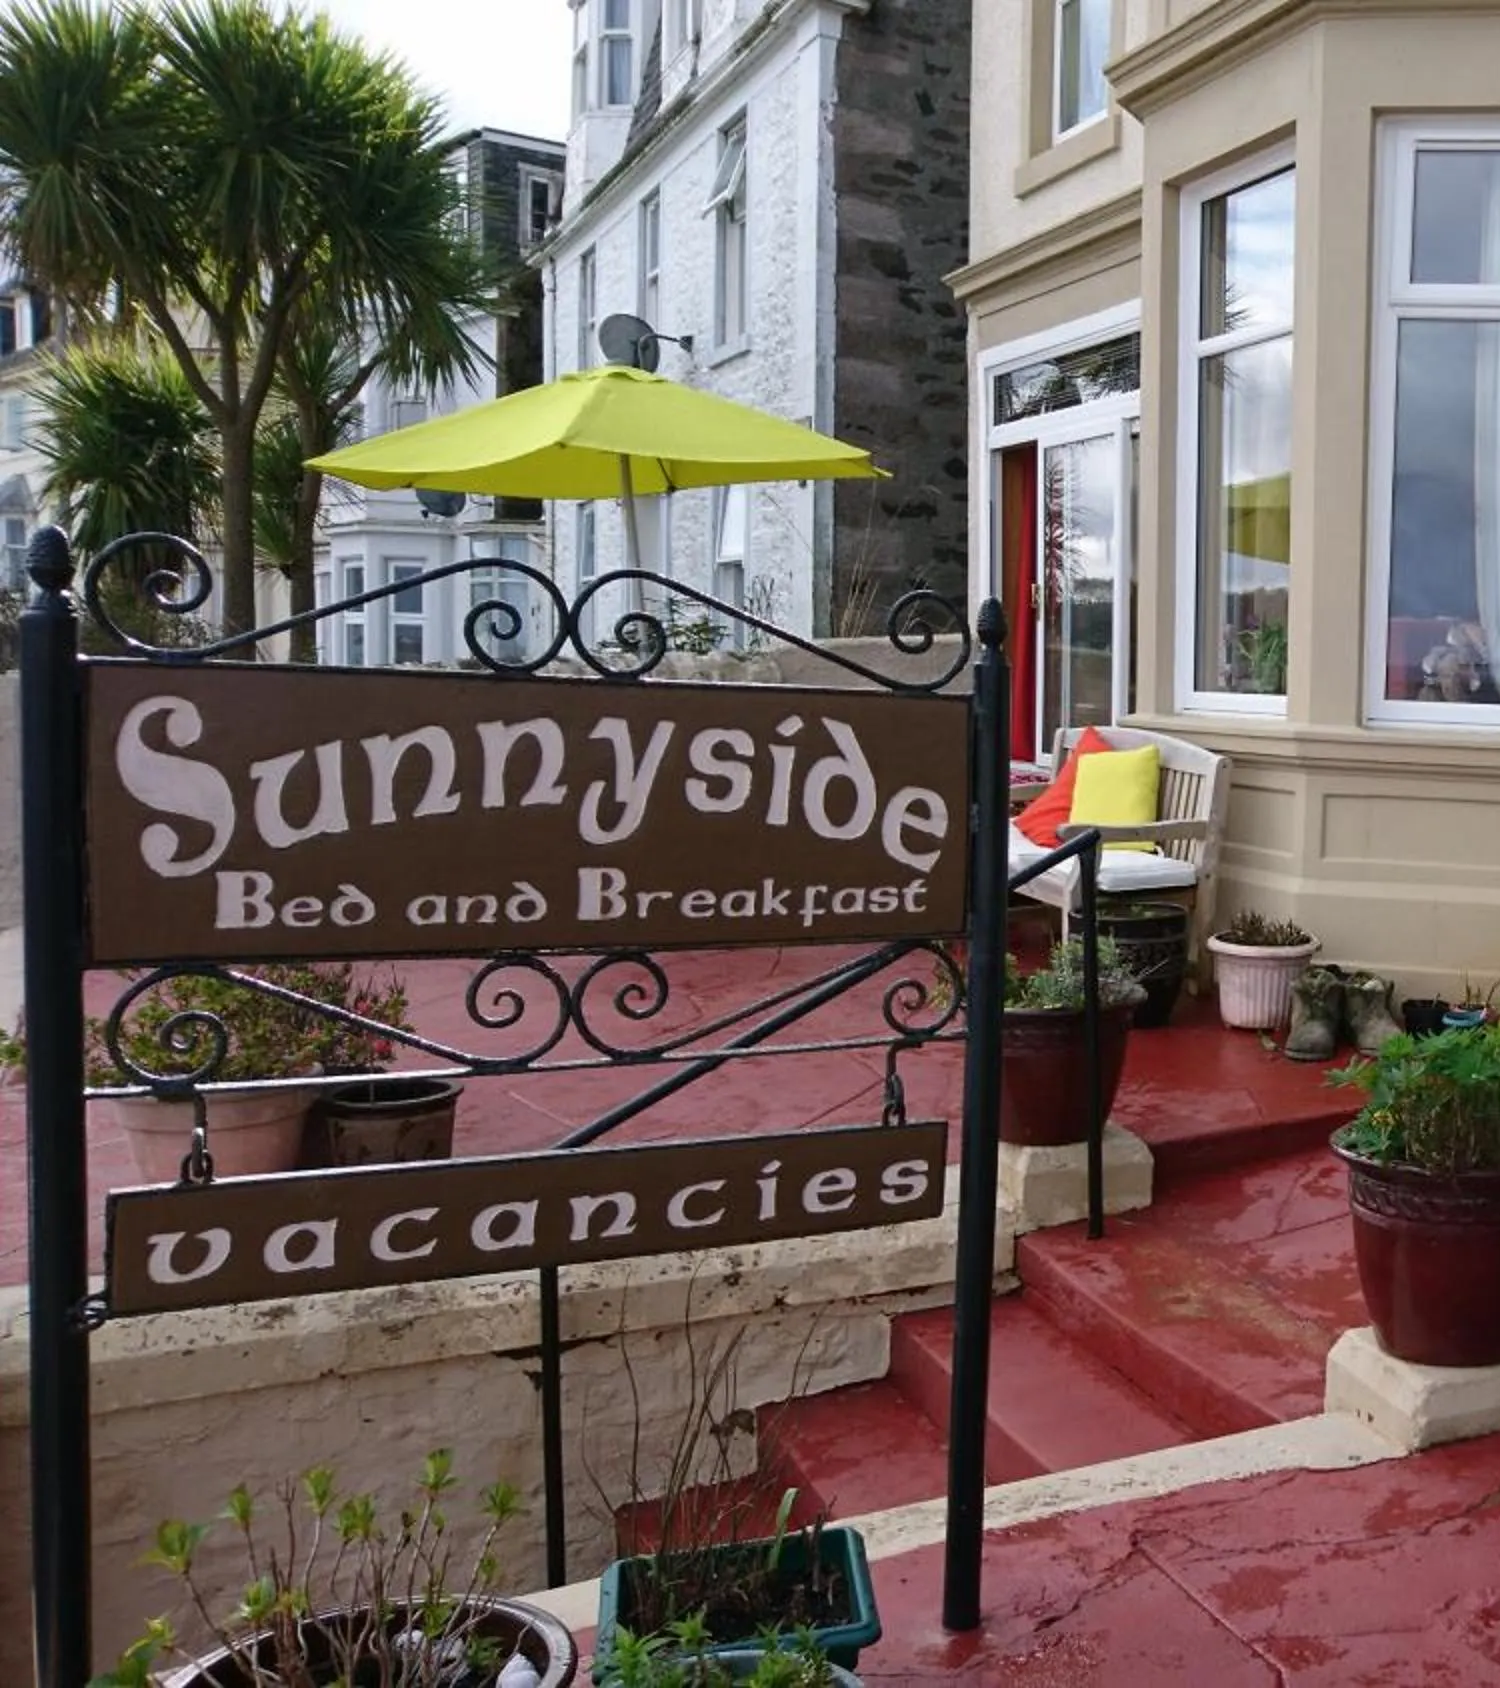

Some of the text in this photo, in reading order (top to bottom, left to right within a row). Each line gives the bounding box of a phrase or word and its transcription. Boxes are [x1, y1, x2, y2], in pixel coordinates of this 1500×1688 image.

[116, 695, 949, 878] Sunnyside
[214, 867, 928, 930] Bed and Breakfast
[147, 1159, 930, 1284] vacancies
